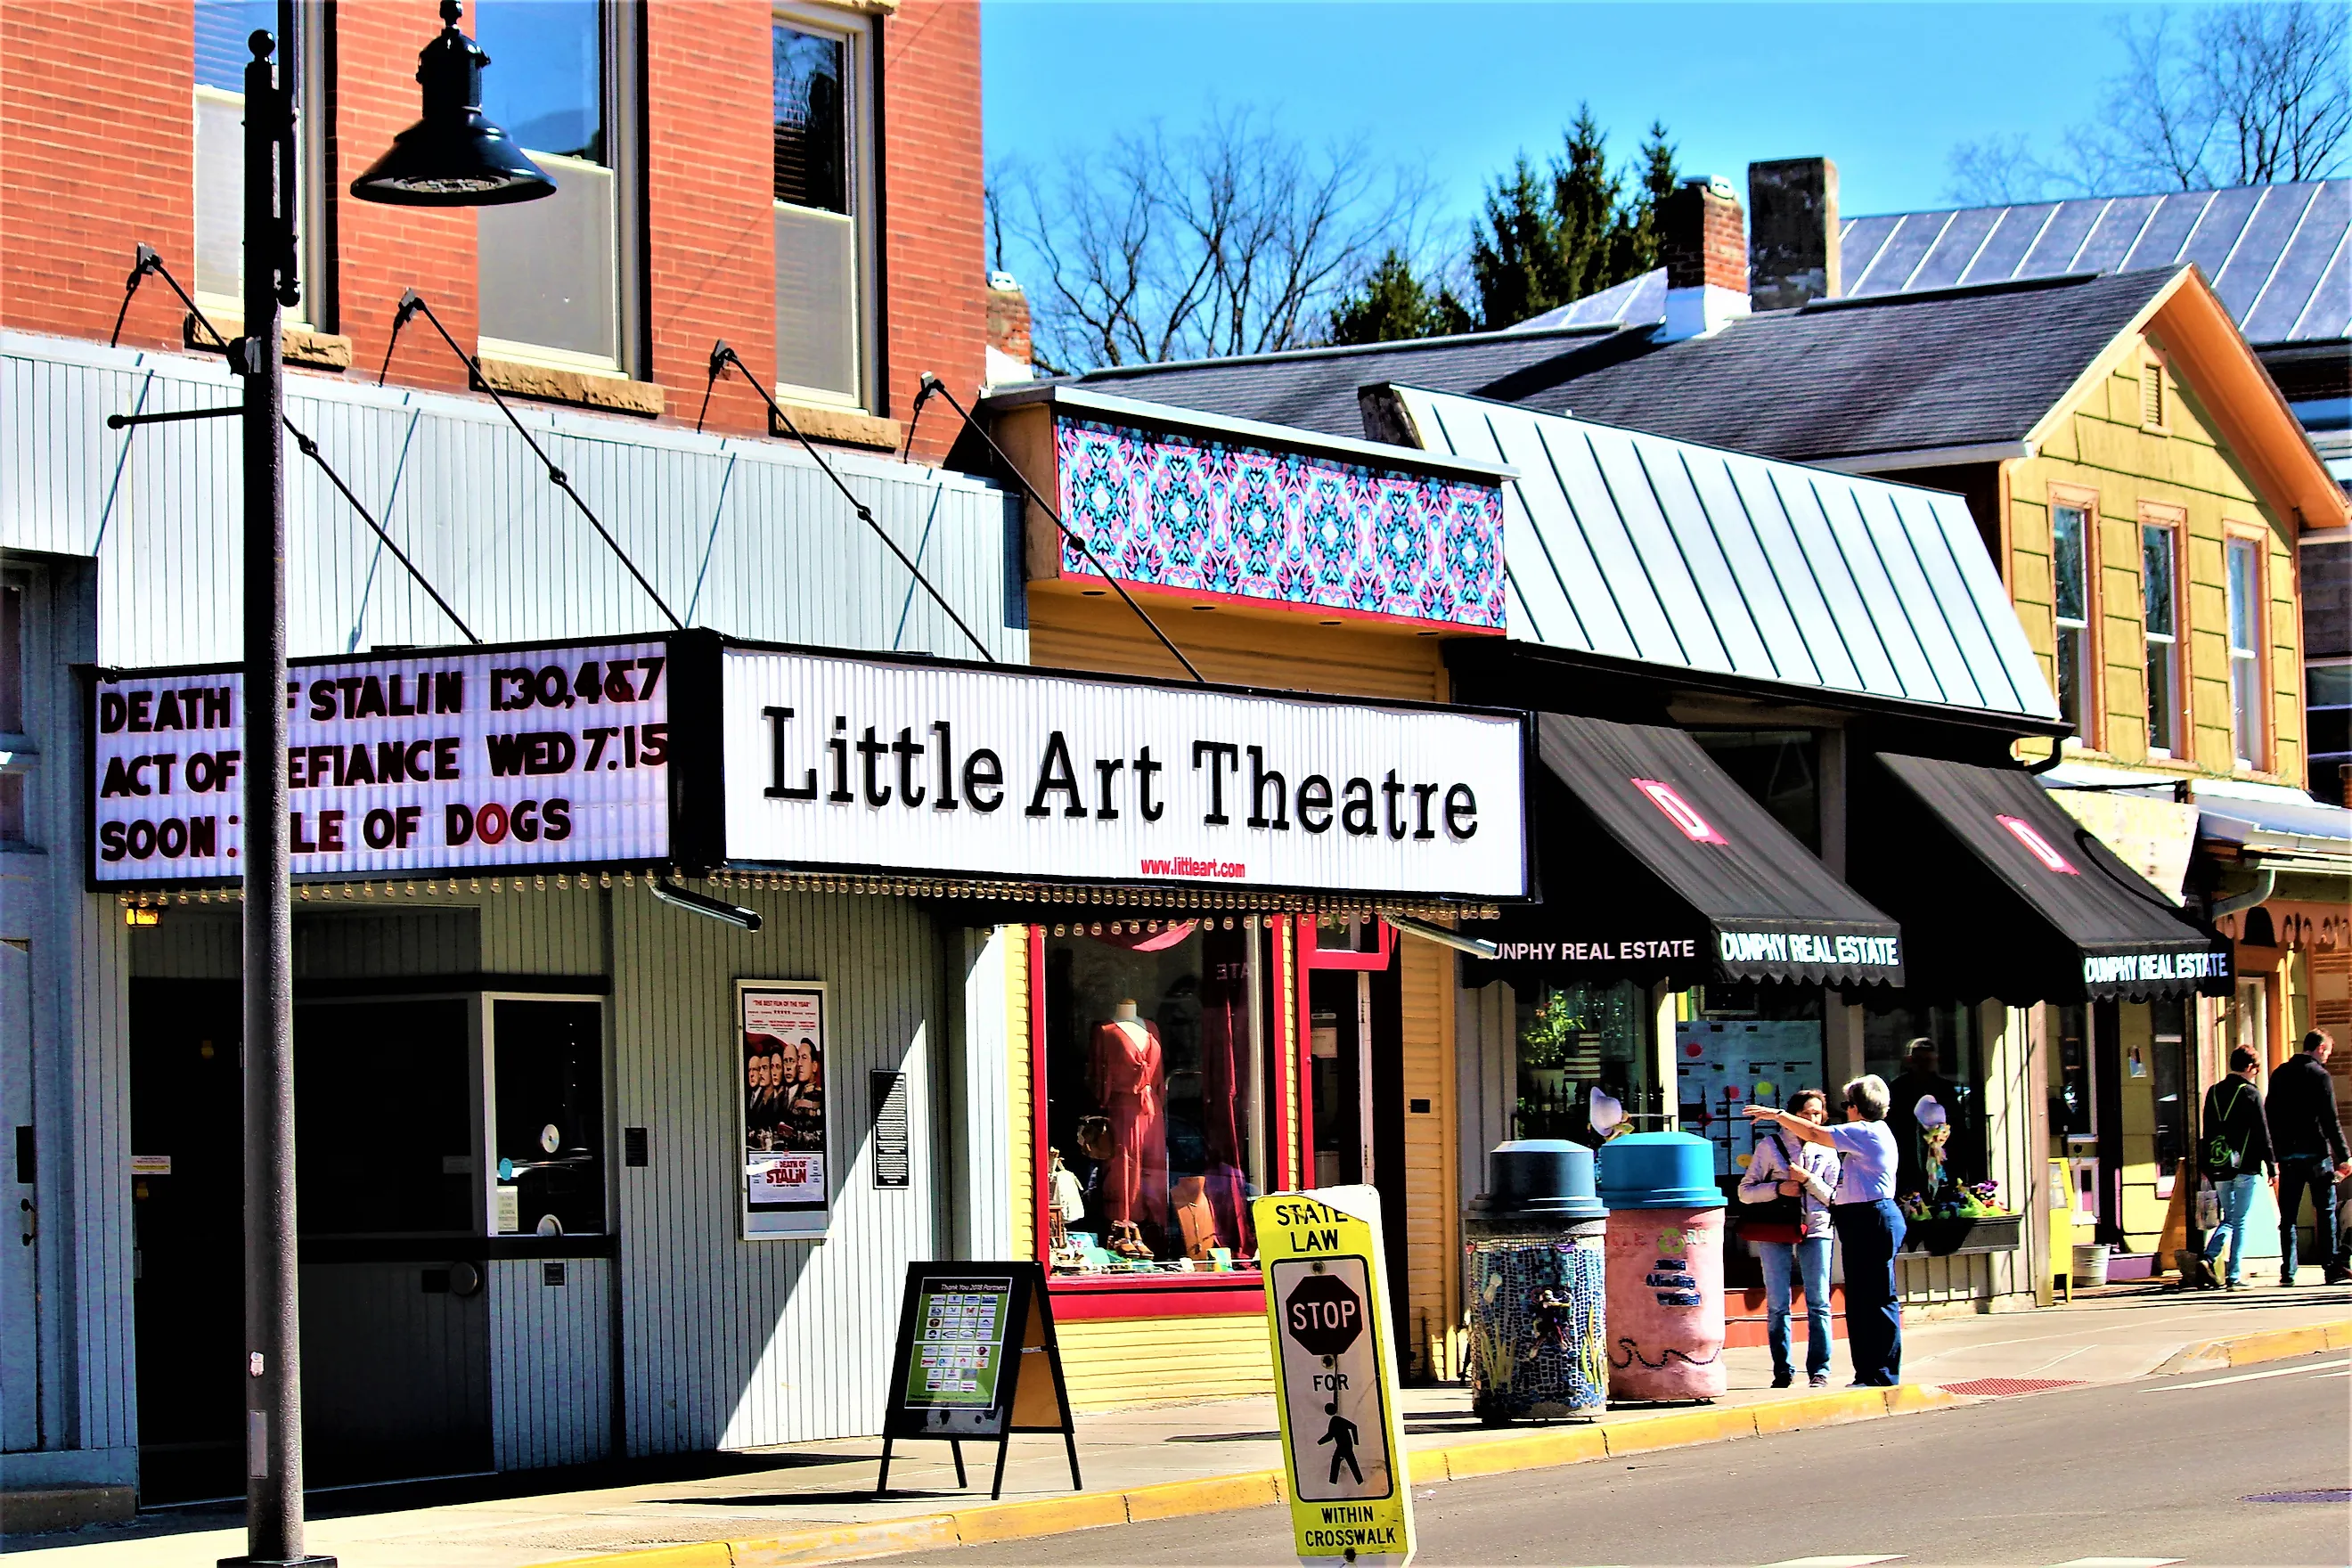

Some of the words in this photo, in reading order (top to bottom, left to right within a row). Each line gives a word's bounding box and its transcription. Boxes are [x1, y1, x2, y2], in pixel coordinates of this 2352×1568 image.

[100, 685, 232, 735] DEATH
[309, 670, 463, 722] STALIN
[100, 754, 178, 799] ACT
[184, 750, 241, 794] OF
[287, 737, 461, 788] EFIANCE
[486, 731, 577, 779] WED
[762, 706, 1006, 814] Little
[1025, 731, 1163, 823] Art
[1193, 740, 1479, 841] Theatre
[363, 804, 422, 850] OF
[445, 798, 573, 846] DOGS
[1140, 856, 1245, 878] www.littleart.com
[1477, 943, 1556, 960] UNPHY
[1561, 943, 1615, 960] REAL
[1620, 940, 1695, 960] ESTATE
[1719, 931, 1788, 963] DUNPHY
[1788, 934, 1838, 964] REAL
[1835, 935, 1900, 967] ESTATE
[2138, 953, 2176, 980] REAL
[2176, 952, 2229, 979] ESTATE
[780, 1160, 798, 1168] DEATH
[799, 1160, 807, 1168] OF
[1276, 1204, 1350, 1227] STATE
[1290, 1229, 1339, 1253] LAW
[1293, 1301, 1357, 1331] STOP
[1312, 1374, 1350, 1392] FOR
[1320, 1506, 1375, 1524] WITHIN
[1305, 1528, 1397, 1548] CROSSWALK
